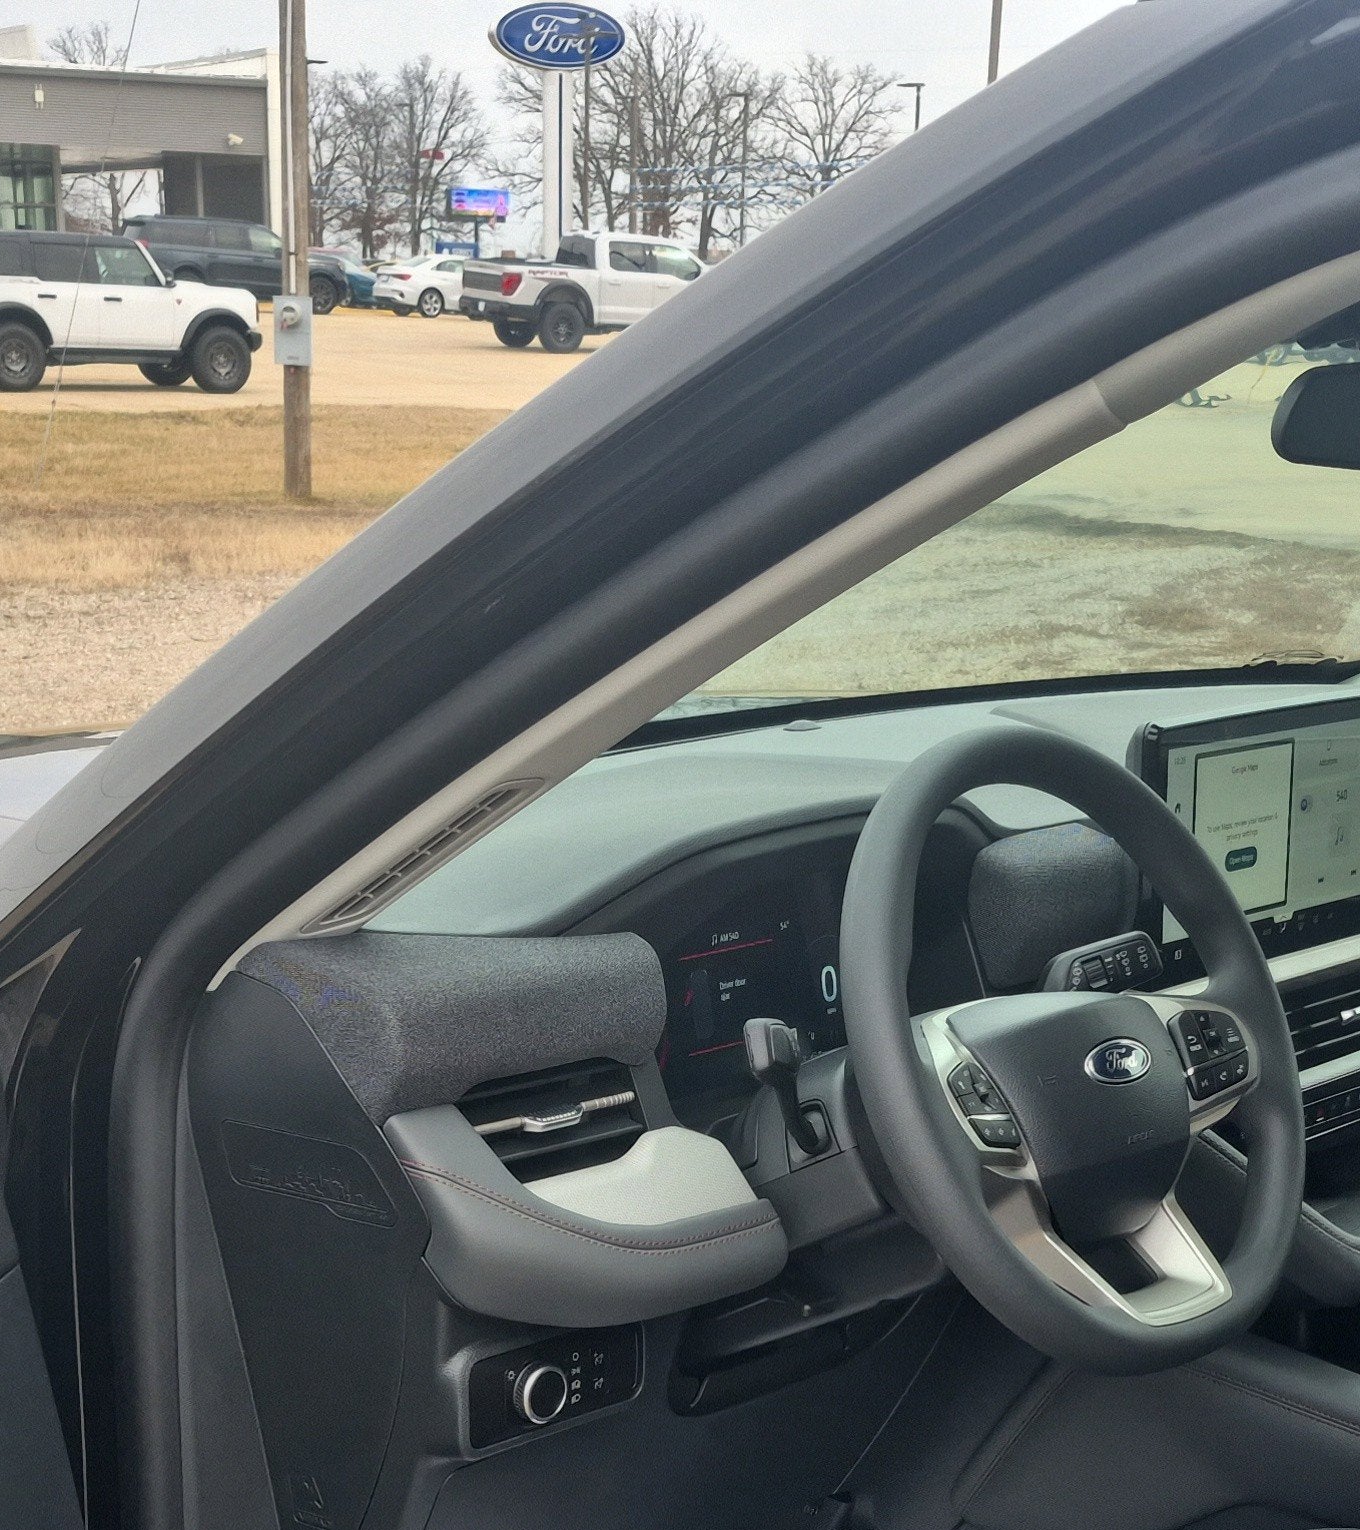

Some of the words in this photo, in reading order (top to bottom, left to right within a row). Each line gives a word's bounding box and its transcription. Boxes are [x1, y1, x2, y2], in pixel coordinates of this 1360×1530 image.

[524, 14, 600, 54] Ford
[719, 933, 729, 943] AM
[821, 965, 838, 1003] 0
[1105, 1047, 1138, 1072] Ford
